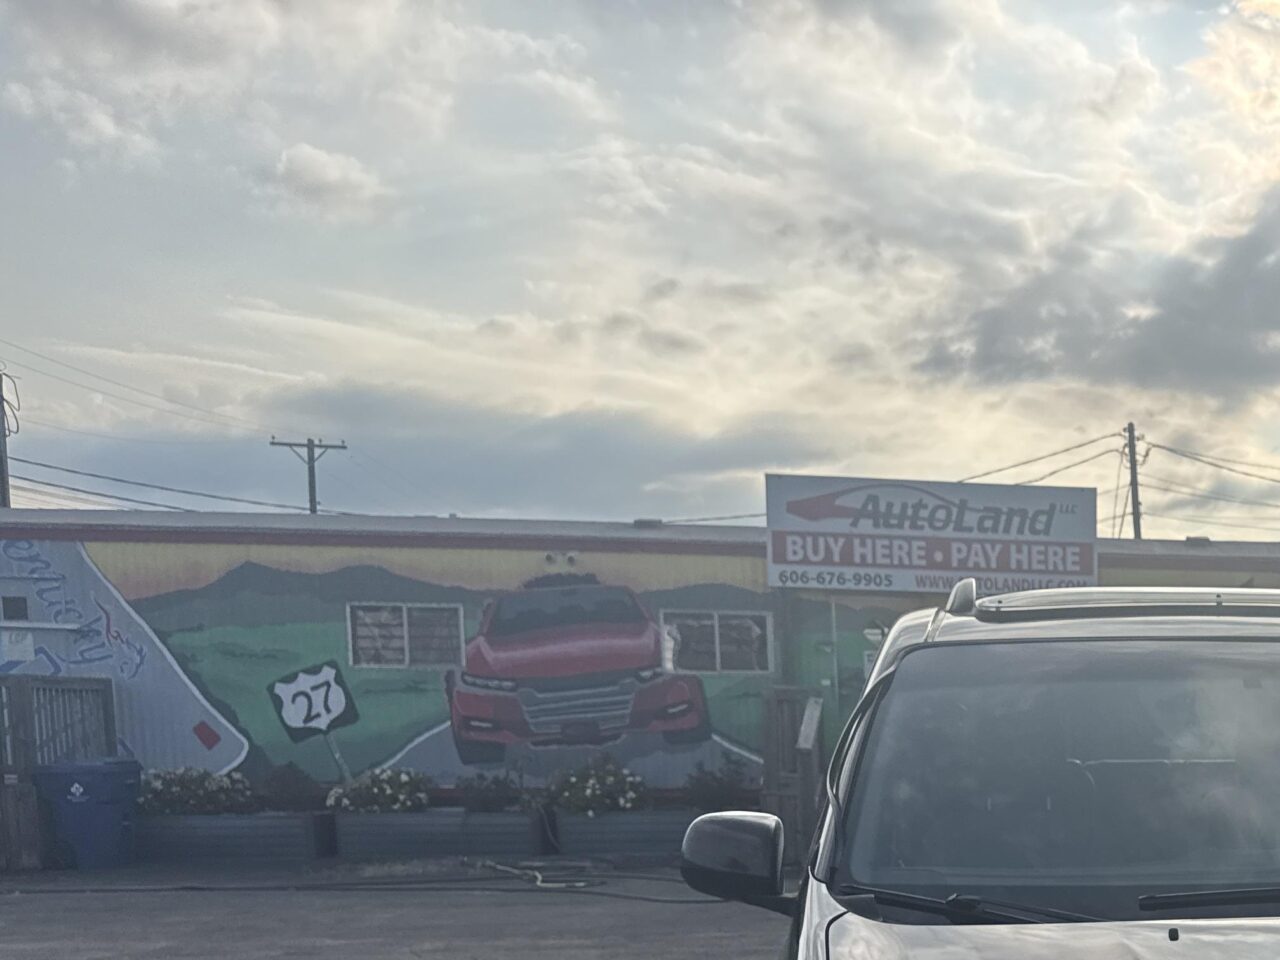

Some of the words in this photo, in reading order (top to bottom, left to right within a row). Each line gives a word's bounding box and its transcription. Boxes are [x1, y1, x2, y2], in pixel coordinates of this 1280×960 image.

[850, 493, 1056, 537] AutoLand
[785, 534, 844, 562] BUY
[853, 537, 927, 567] HERE
[951, 541, 1002, 571] PAY
[1009, 542, 1081, 572] HERE
[778, 570, 894, 588] 606-676-9905
[291, 680, 333, 726] 27
